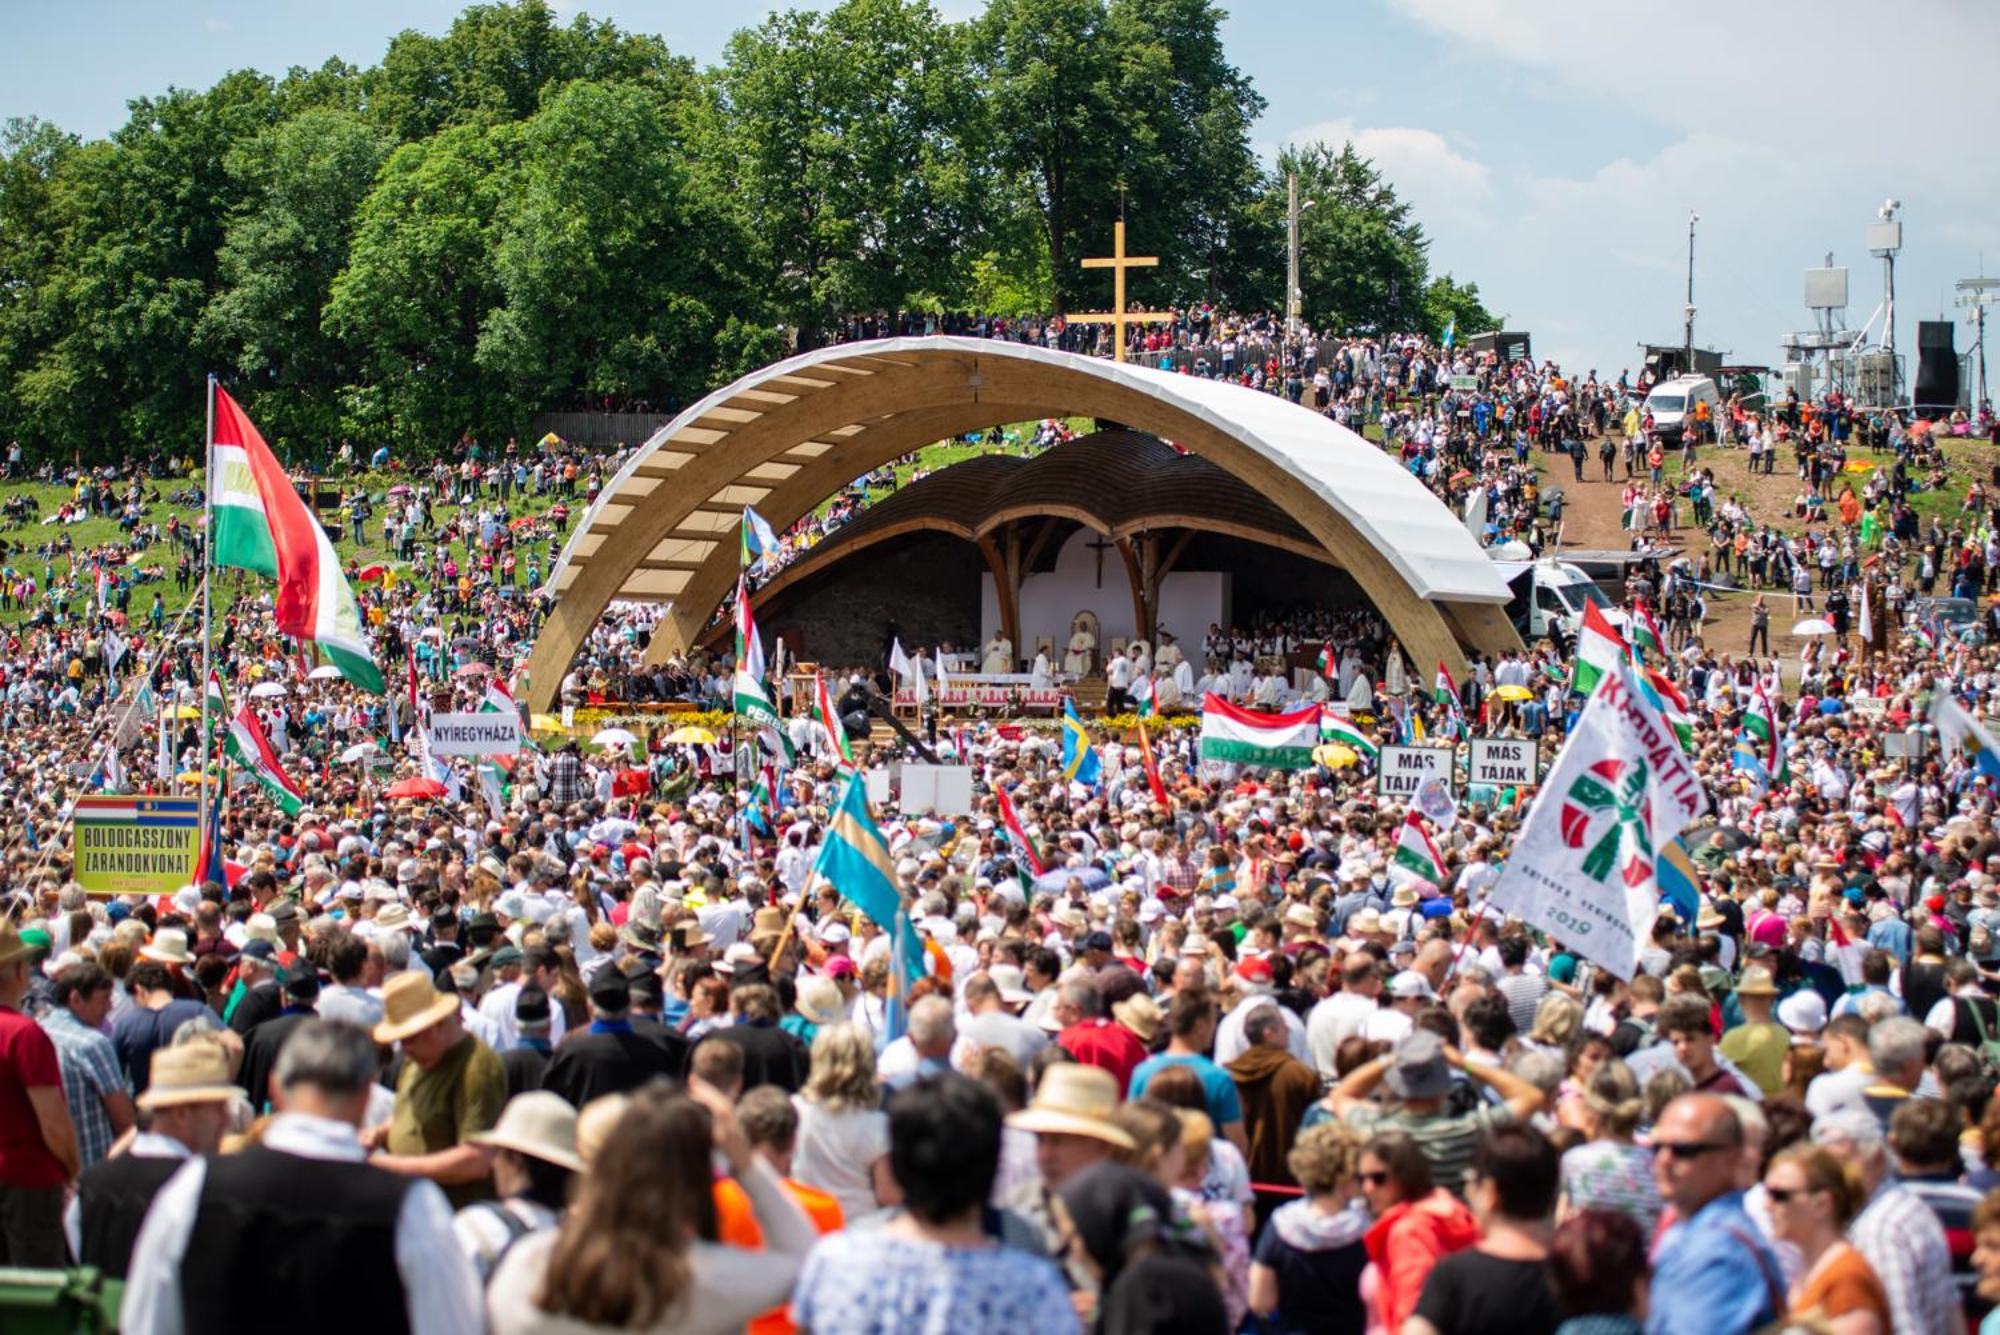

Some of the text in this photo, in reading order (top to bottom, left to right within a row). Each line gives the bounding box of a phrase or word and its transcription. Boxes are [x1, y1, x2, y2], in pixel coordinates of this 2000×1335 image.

[434, 721, 515, 742] NYÍREGYHÁZA
[1398, 750, 1435, 769] MÁS
[1487, 742, 1521, 761] MÁS
[1480, 763, 1527, 781] TÁJAK
[84, 827, 191, 849] BOLDOGASSZONY
[85, 850, 190, 874] ZARÁNDOKVONAT
[1546, 906, 1592, 935] 2019
